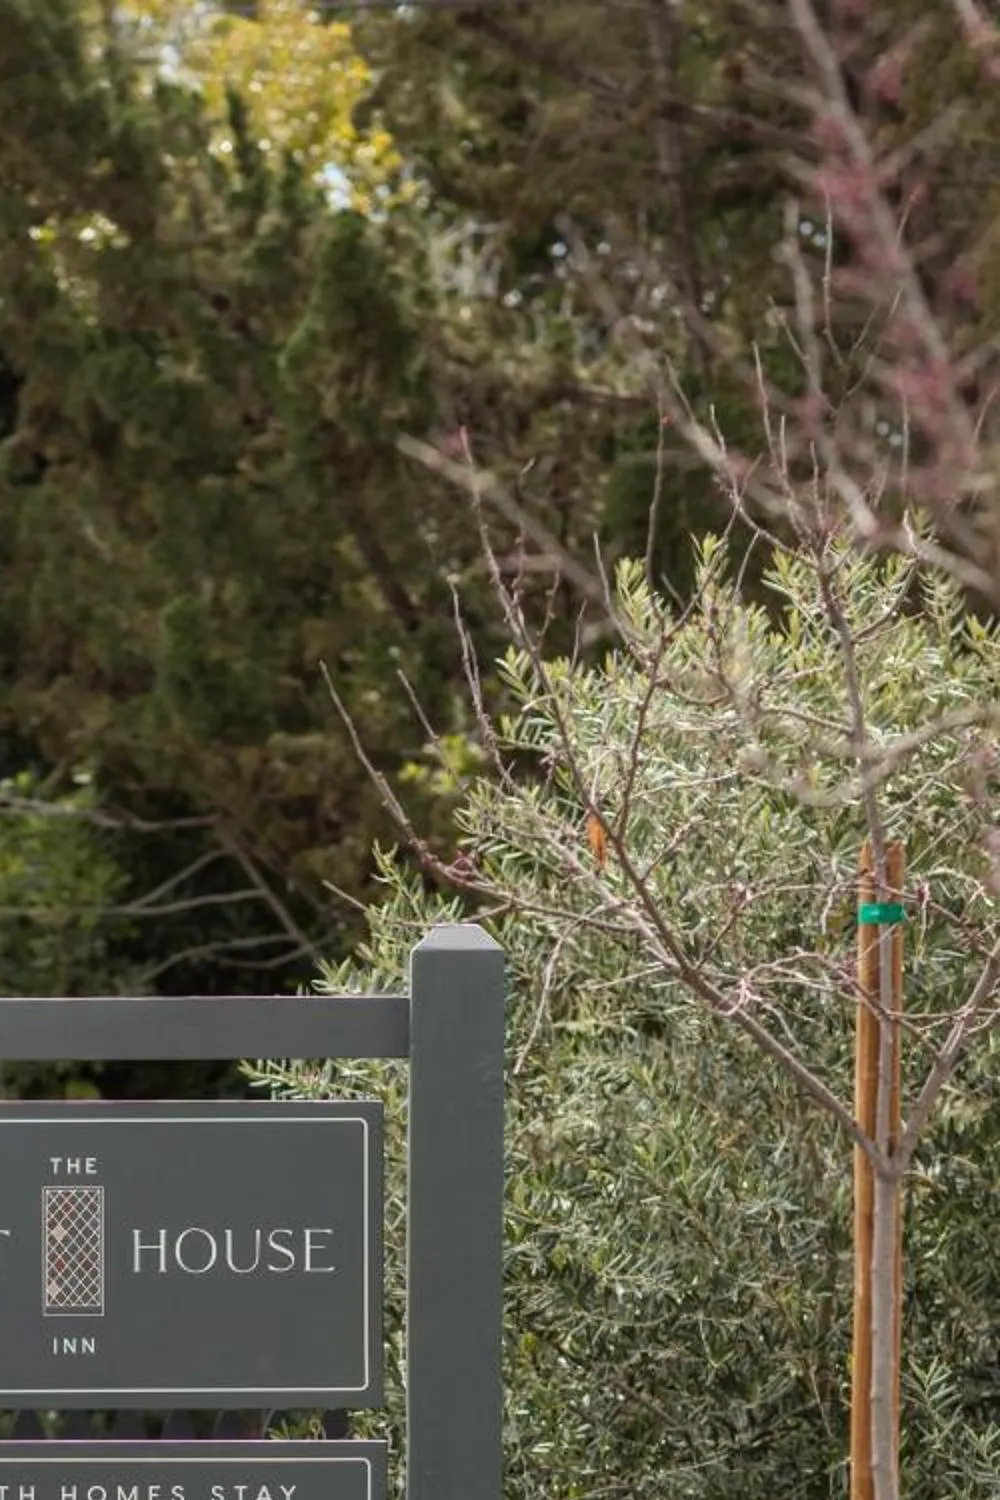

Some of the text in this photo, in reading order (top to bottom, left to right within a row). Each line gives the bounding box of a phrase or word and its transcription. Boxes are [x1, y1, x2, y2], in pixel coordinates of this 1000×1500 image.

[49, 1157, 98, 1175] THE
[132, 1227, 336, 1274] HOUSE
[53, 1337, 96, 1355] INN
